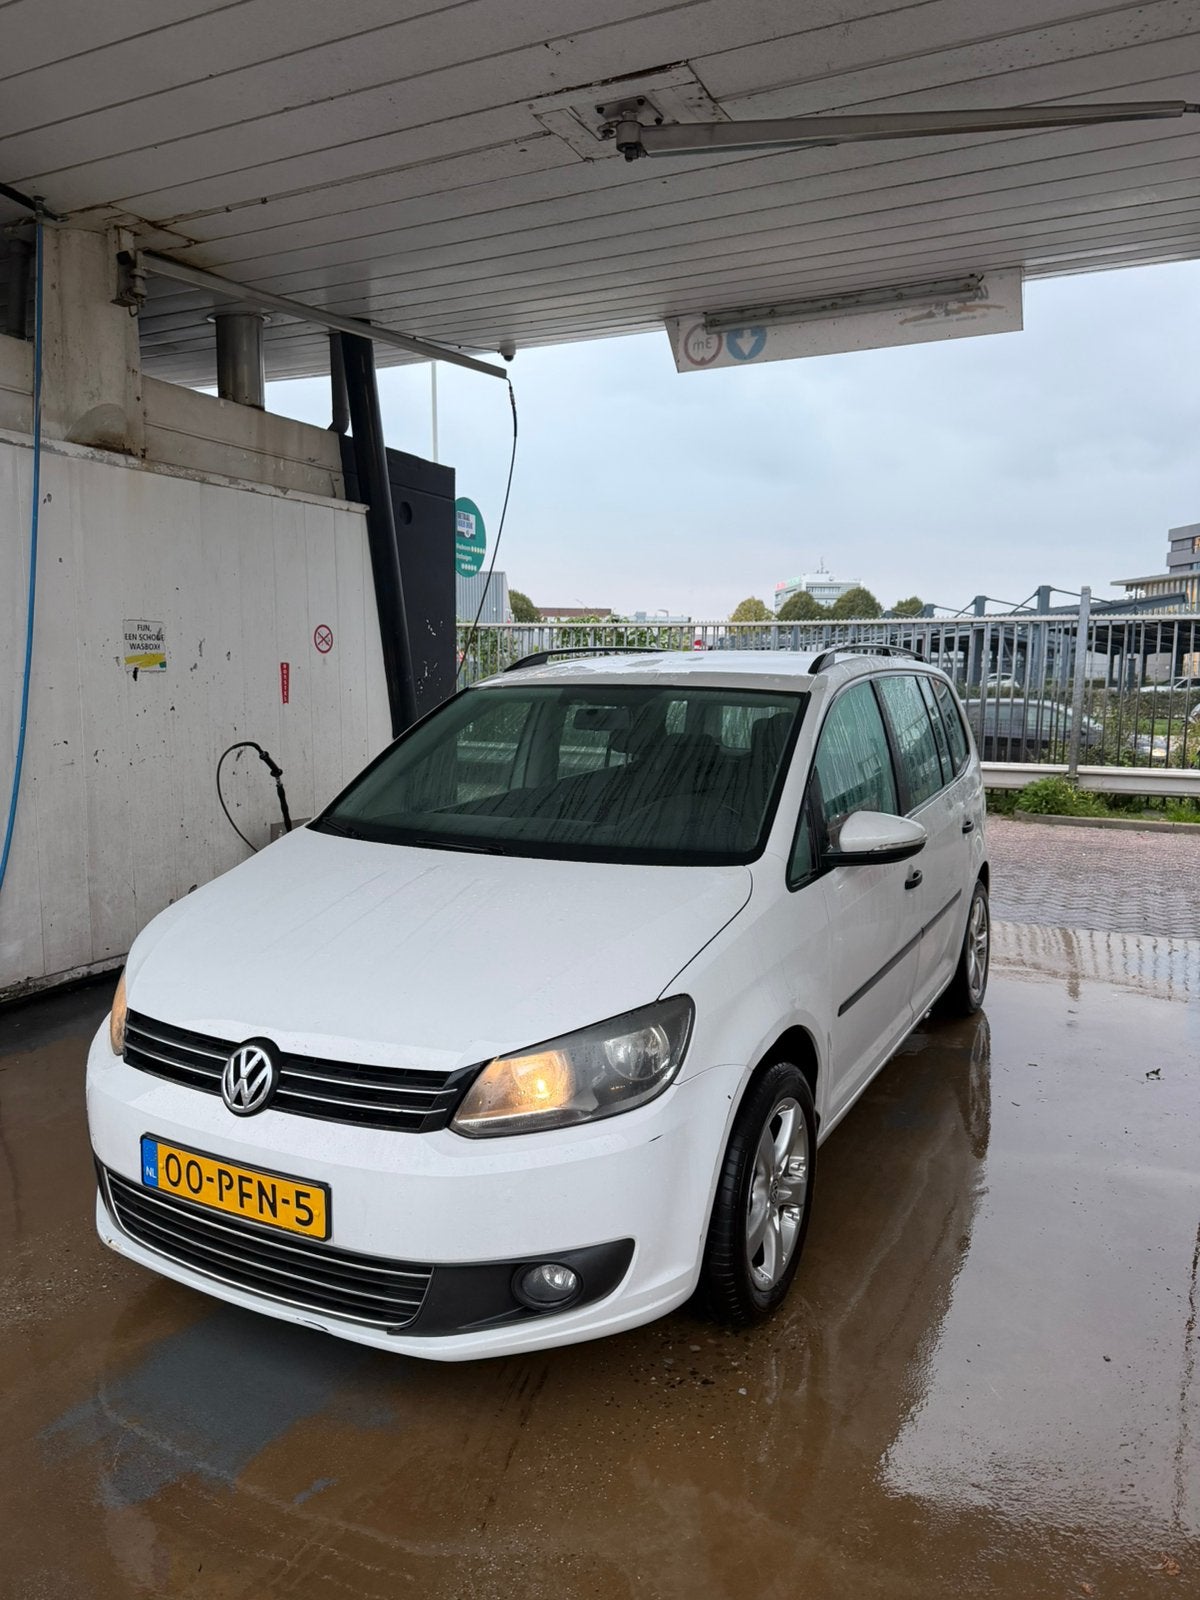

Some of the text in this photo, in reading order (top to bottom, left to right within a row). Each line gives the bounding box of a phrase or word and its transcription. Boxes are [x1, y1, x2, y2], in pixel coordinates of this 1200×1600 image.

[124, 633, 137, 641] EEN
[145, 1153, 314, 1227] NL 00-PFN-5
